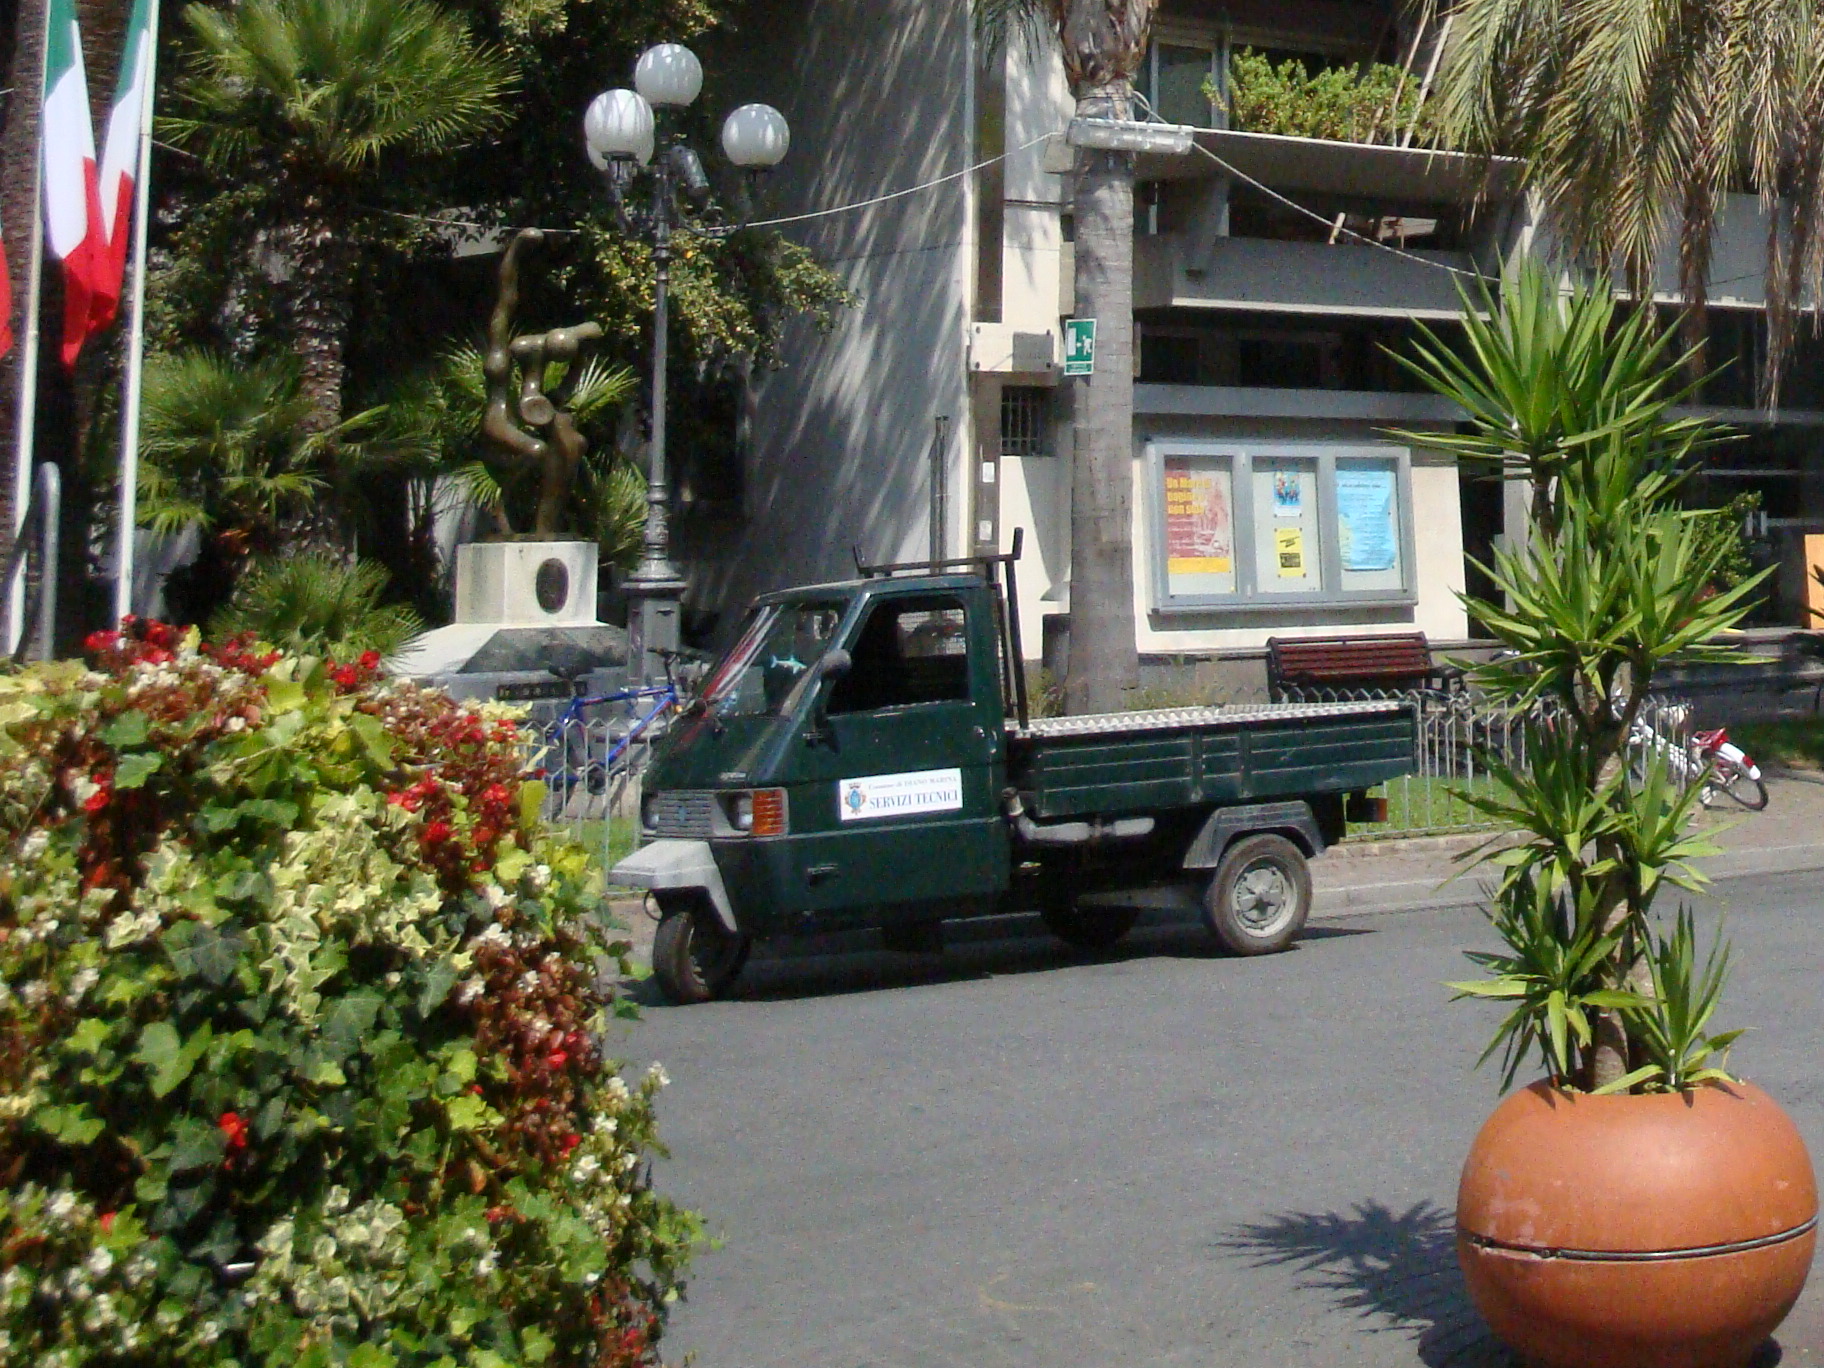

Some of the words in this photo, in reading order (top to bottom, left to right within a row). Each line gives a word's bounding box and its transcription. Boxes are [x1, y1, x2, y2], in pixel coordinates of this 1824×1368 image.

[904, 779, 928, 788] DIANO
[929, 776, 957, 785] MARINA
[869, 793, 912, 810] SERVIZI
[915, 789, 958, 806] TECNICI
